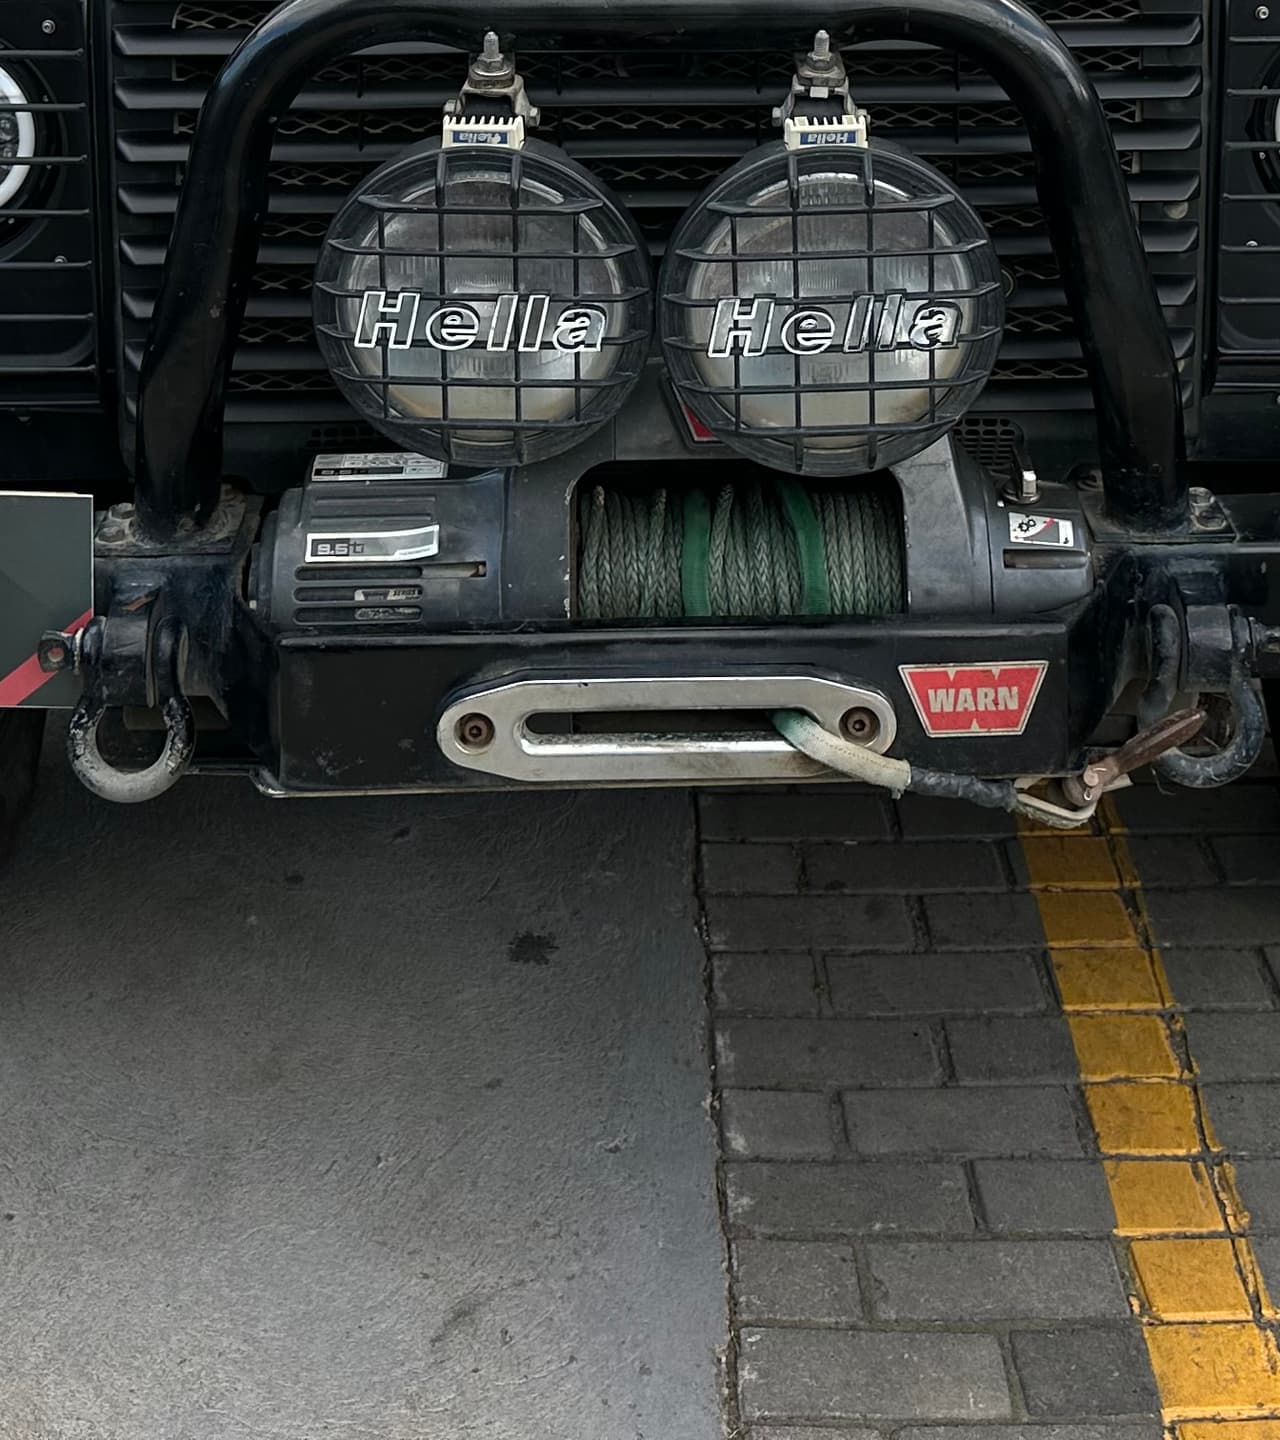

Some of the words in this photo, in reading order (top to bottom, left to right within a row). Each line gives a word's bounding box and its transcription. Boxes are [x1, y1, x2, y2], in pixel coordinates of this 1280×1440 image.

[807, 132, 849, 145] Hella
[353, 286, 609, 353] Hella
[707, 291, 962, 359] Hella
[927, 686, 1019, 713] WARN
